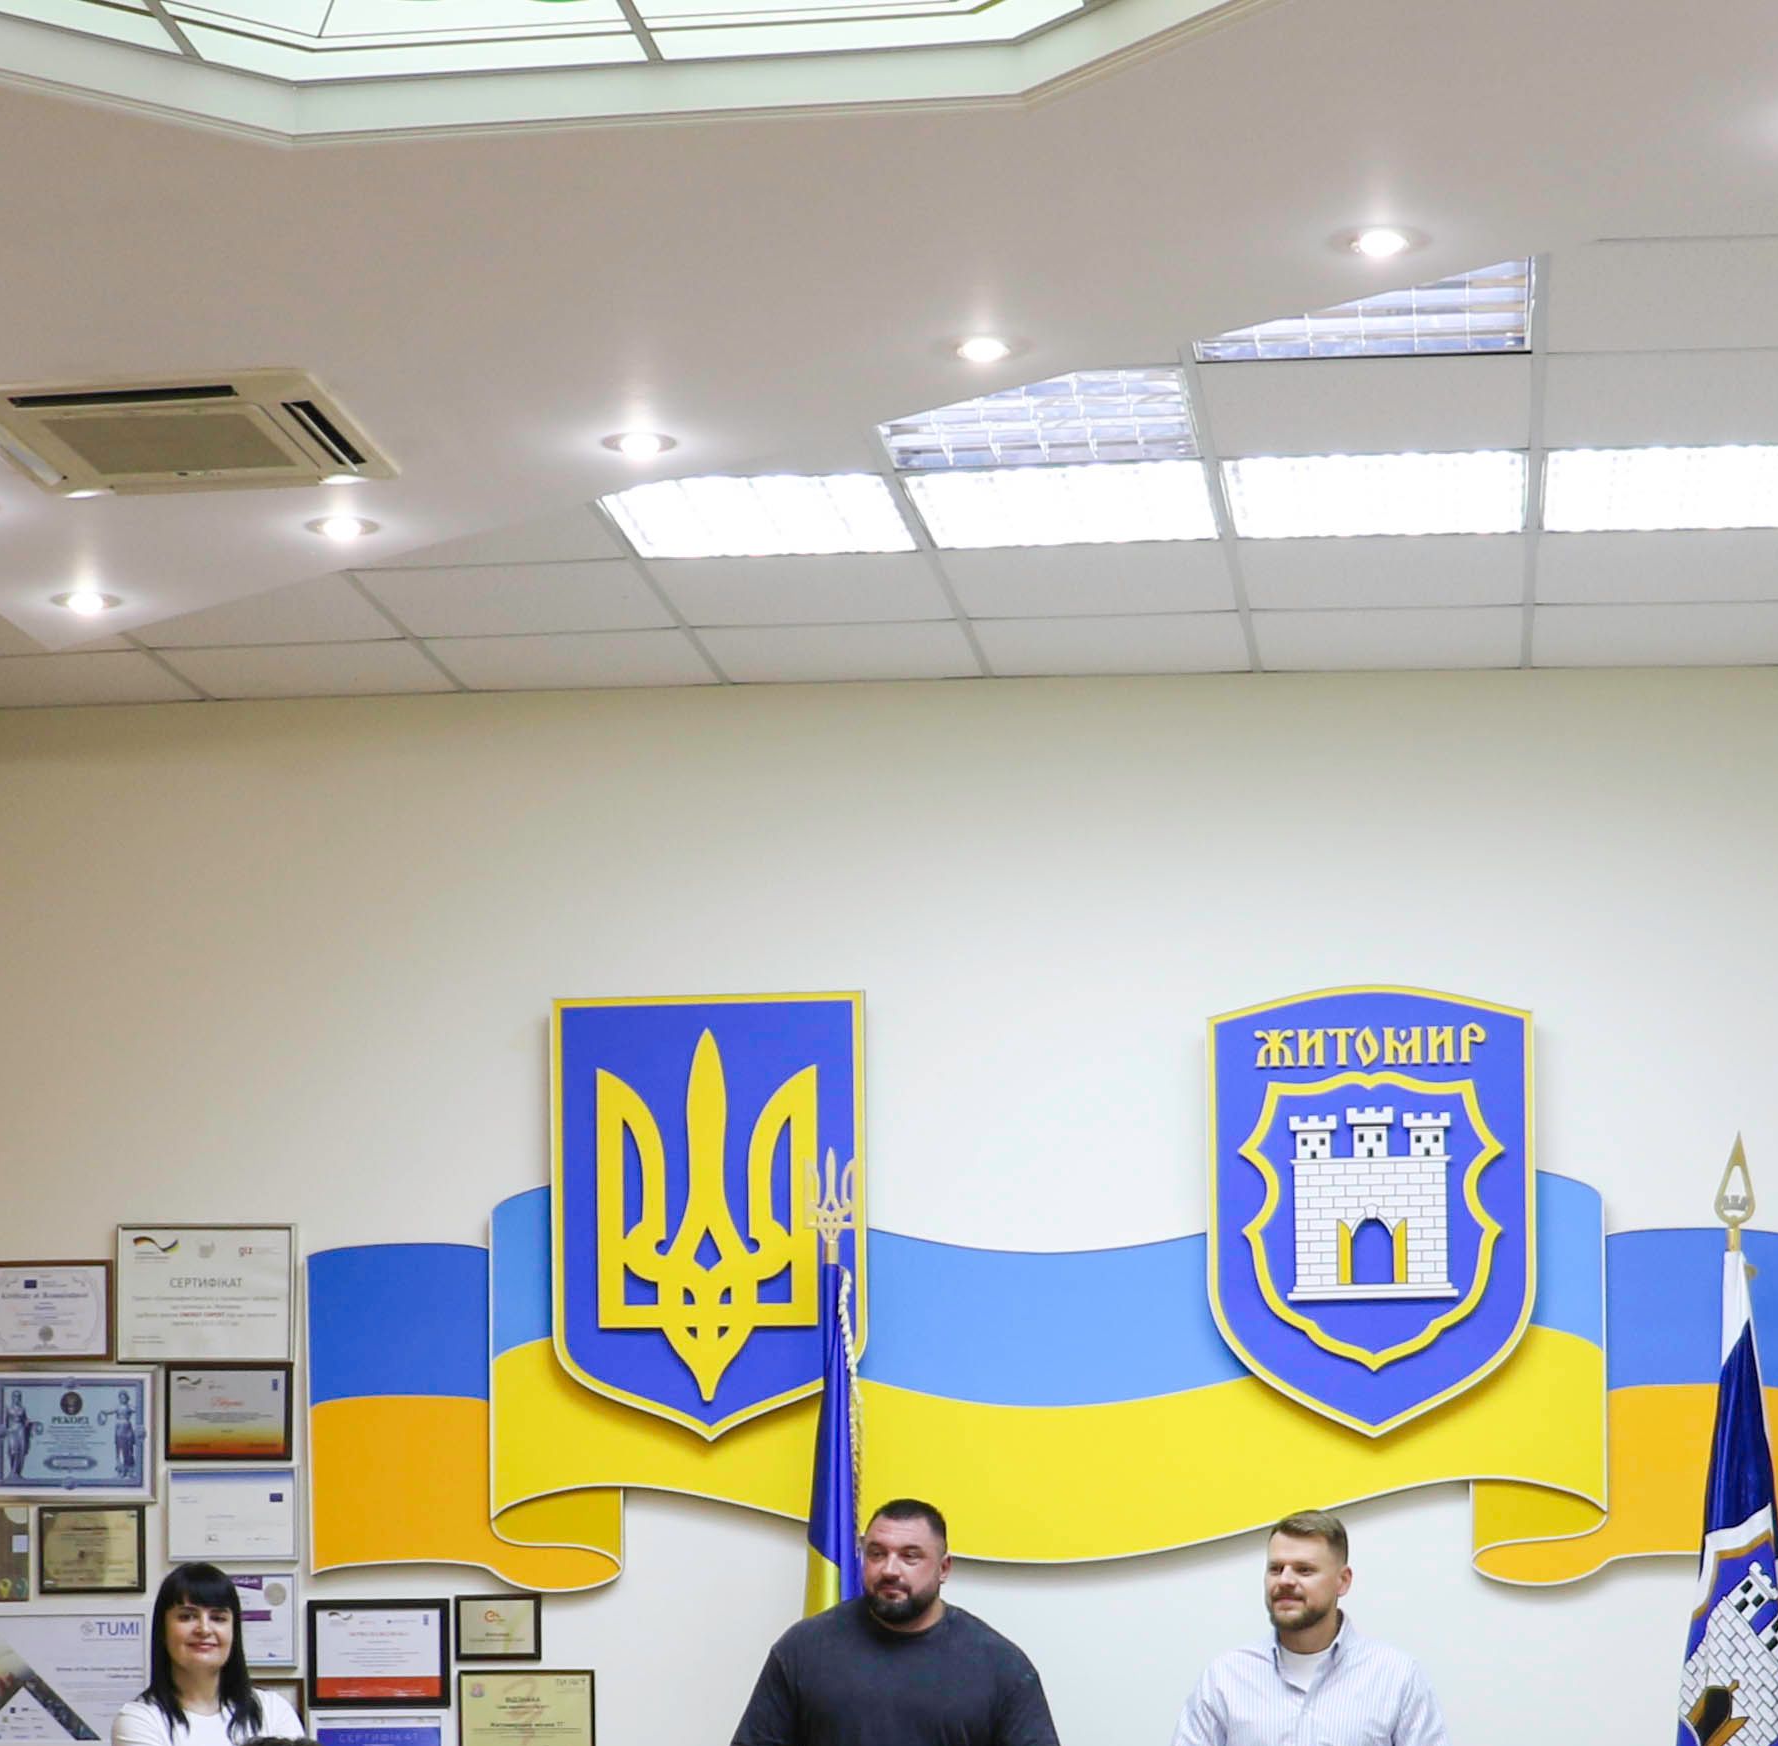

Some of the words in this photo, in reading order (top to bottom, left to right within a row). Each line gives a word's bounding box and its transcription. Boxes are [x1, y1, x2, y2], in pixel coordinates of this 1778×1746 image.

[1254, 1022, 1487, 1067] ЖИТОМИР
[169, 1277, 243, 1289] СЕРТИФІКАТ
[95, 1621, 139, 1636] TUMI
